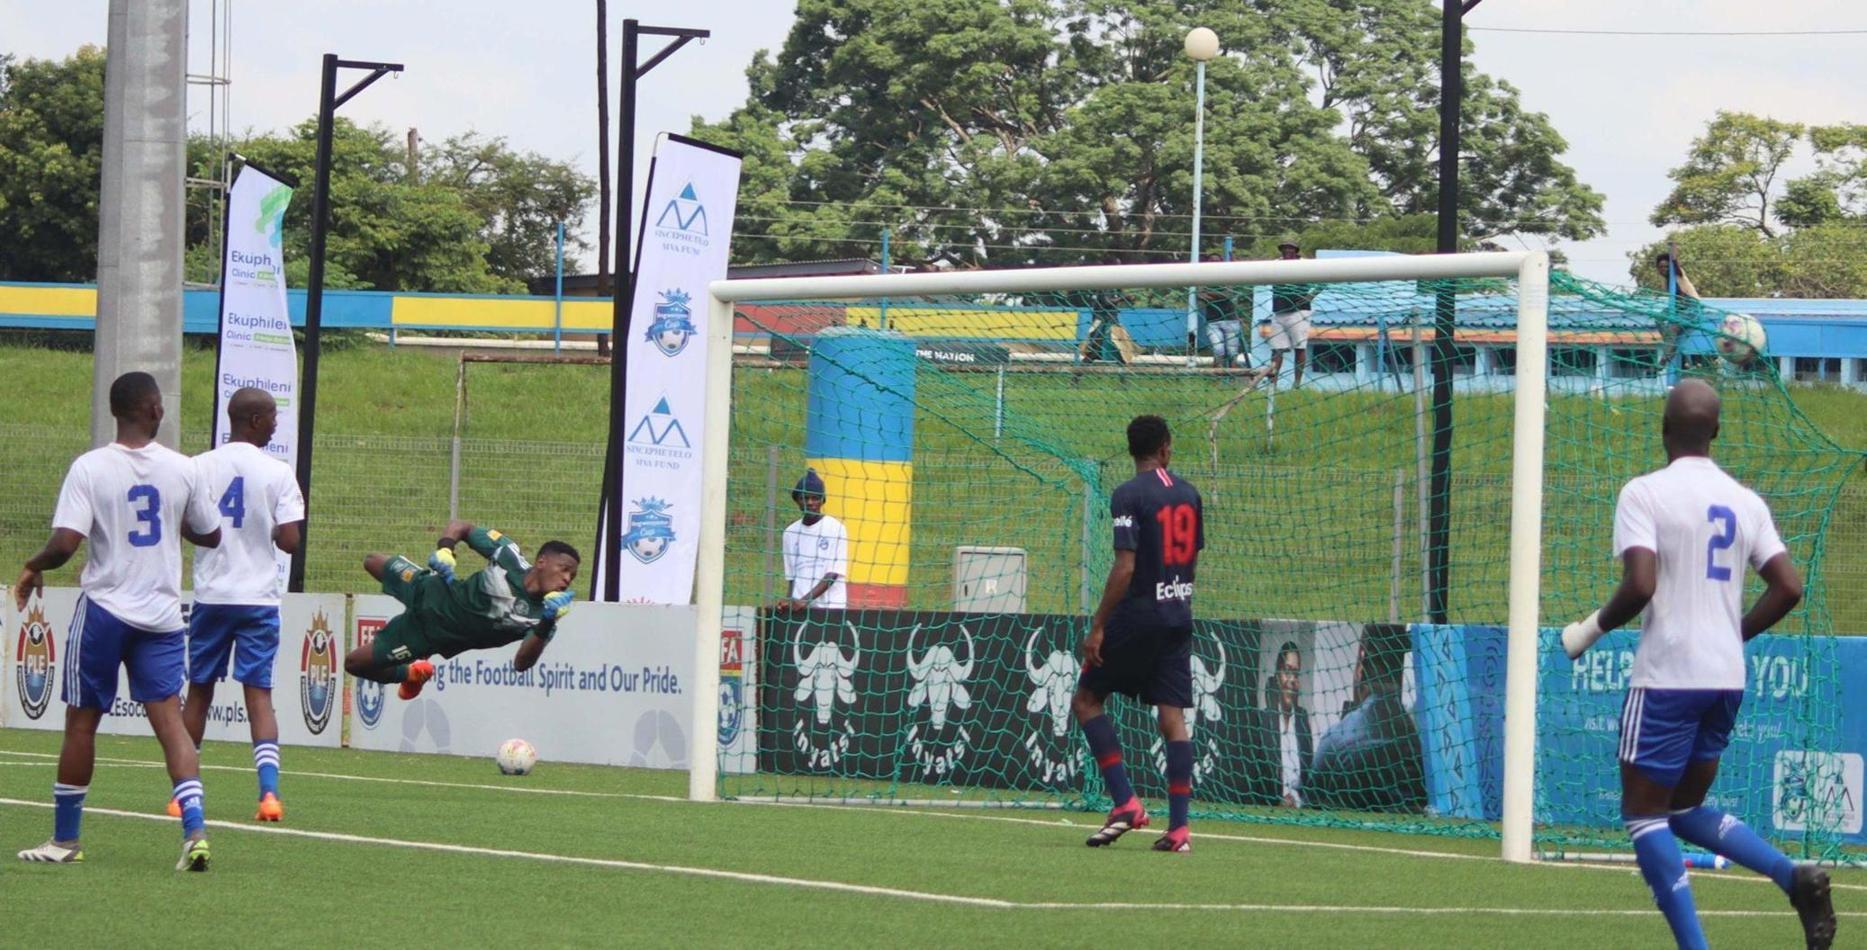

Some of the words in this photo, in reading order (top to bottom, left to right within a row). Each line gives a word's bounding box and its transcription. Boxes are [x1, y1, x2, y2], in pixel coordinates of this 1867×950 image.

[915, 349, 933, 359] THE
[934, 351, 975, 362] NATION
[654, 460, 680, 470] FUND
[128, 484, 162, 547] 3
[218, 476, 245, 529] 4
[1156, 503, 1197, 566] 19
[1706, 505, 1737, 581] 2
[27, 655, 46, 675] PLE
[391, 644, 412, 661] 16
[310, 664, 328, 687] PLE
[449, 658, 472, 685] the
[476, 660, 535, 688] Football
[538, 663, 575, 697] Spirit
[579, 664, 607, 692] and
[611, 665, 639, 692] Our
[643, 666, 682, 694] Pride.
[1752, 654, 1808, 698] YOU
